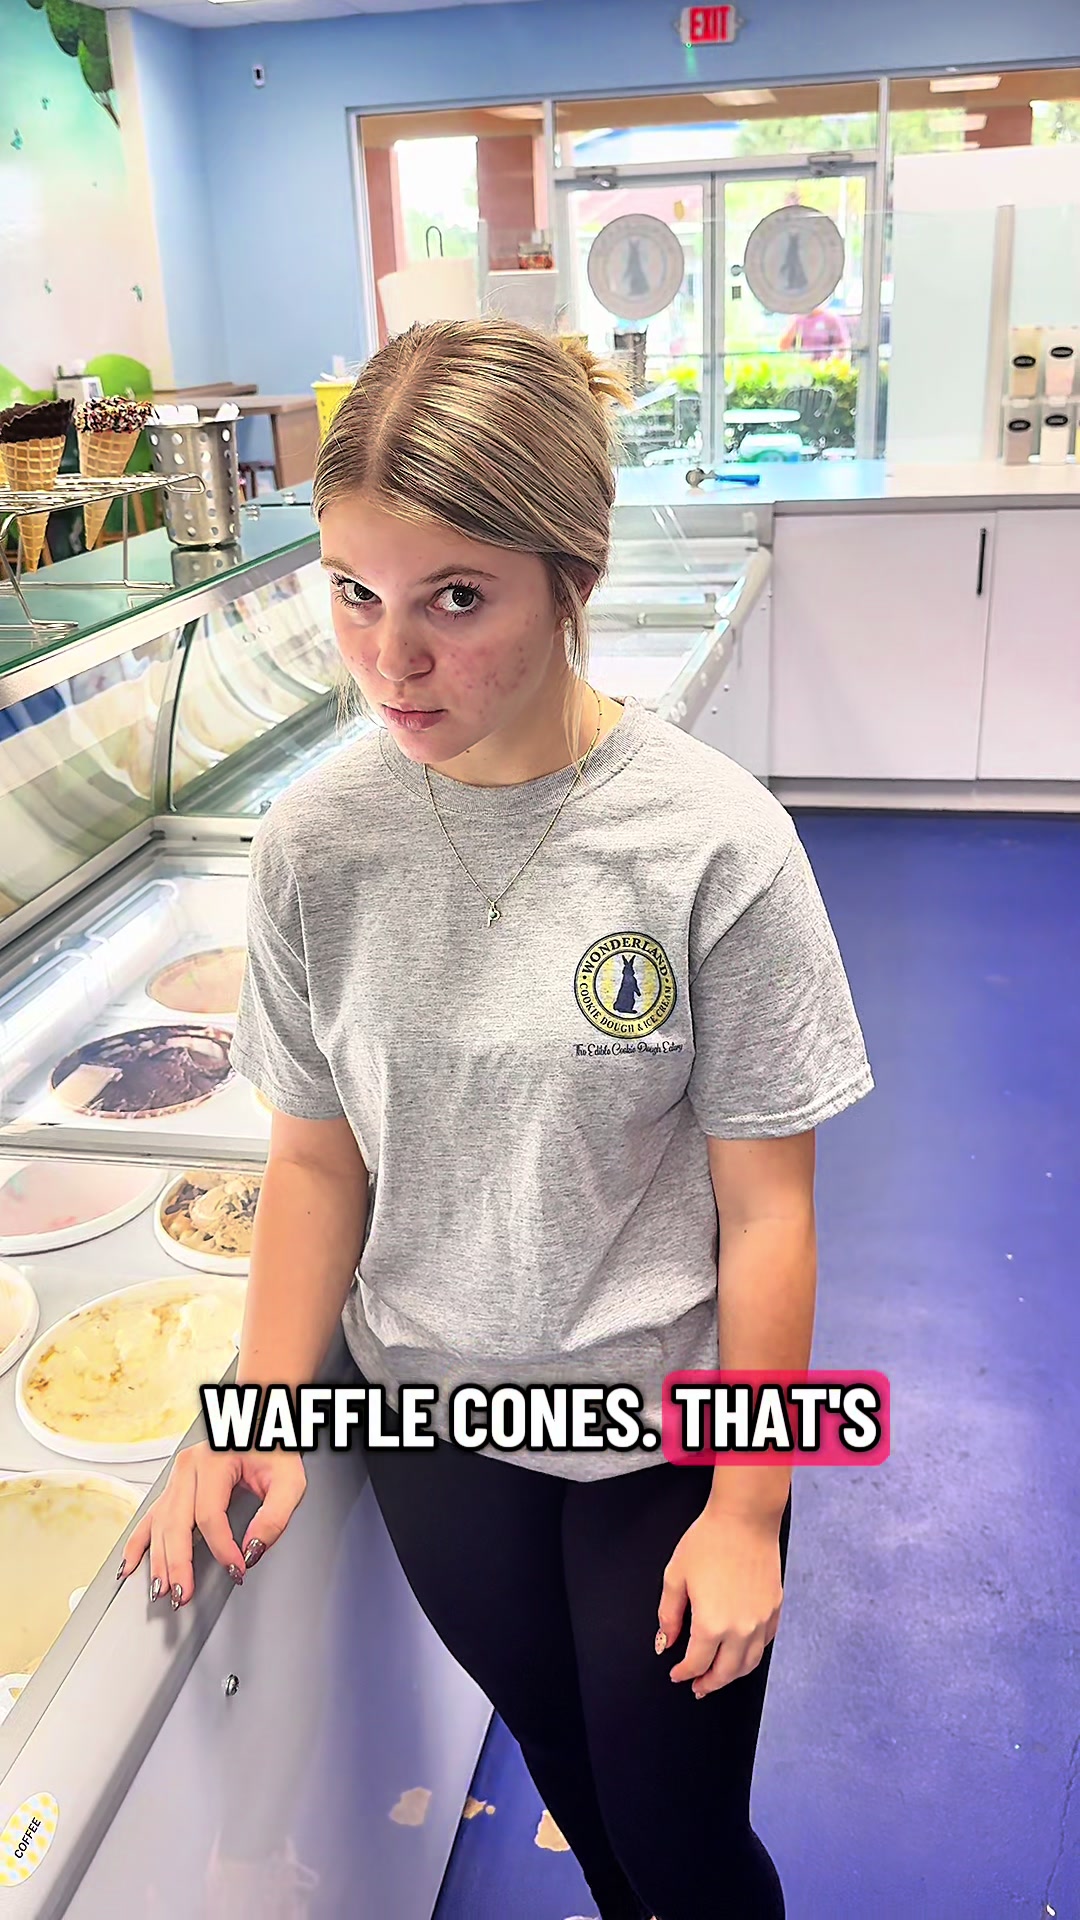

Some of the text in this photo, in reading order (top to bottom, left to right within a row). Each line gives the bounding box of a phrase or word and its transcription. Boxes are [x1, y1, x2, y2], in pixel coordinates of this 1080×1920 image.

[689, 6, 730, 43] EXIT
[582, 937, 668, 976] WONDERLAND
[580, 982, 602, 1019] COOKIE
[600, 1016, 634, 1033] DOUGH
[643, 1014, 658, 1029] ICE
[656, 986, 672, 1017] CREAM
[14, 1817, 41, 1859] COFFEE
